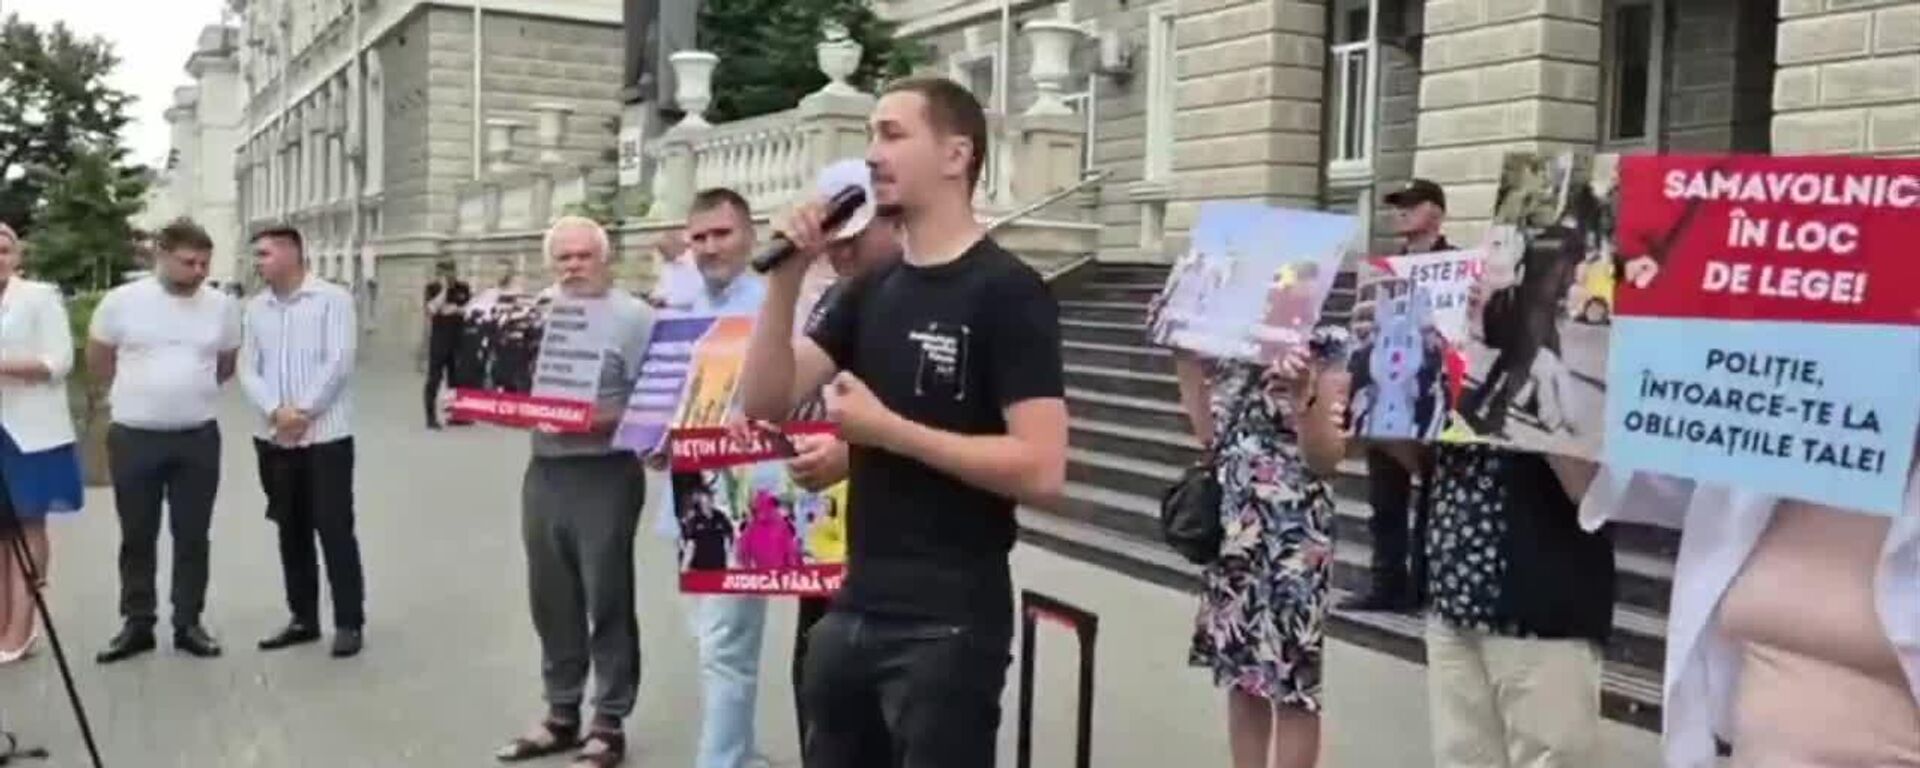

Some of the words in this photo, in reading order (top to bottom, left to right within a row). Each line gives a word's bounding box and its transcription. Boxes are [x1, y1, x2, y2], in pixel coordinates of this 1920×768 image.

[1663, 169, 1920, 207] SAMAVOLNIC
[1727, 210, 1768, 248] ÎN
[1777, 220, 1859, 254] LOC
[1702, 261, 1752, 293] DE
[1758, 266, 1868, 303] LEGE!
[1705, 348, 1825, 389] POLIȚIE,
[1640, 369, 1836, 427] ÎNTOARCE-TE
[1842, 405, 1881, 433] LA
[1623, 410, 1794, 458] OBLIGAȚIILE
[1800, 438, 1886, 474] TALE!
